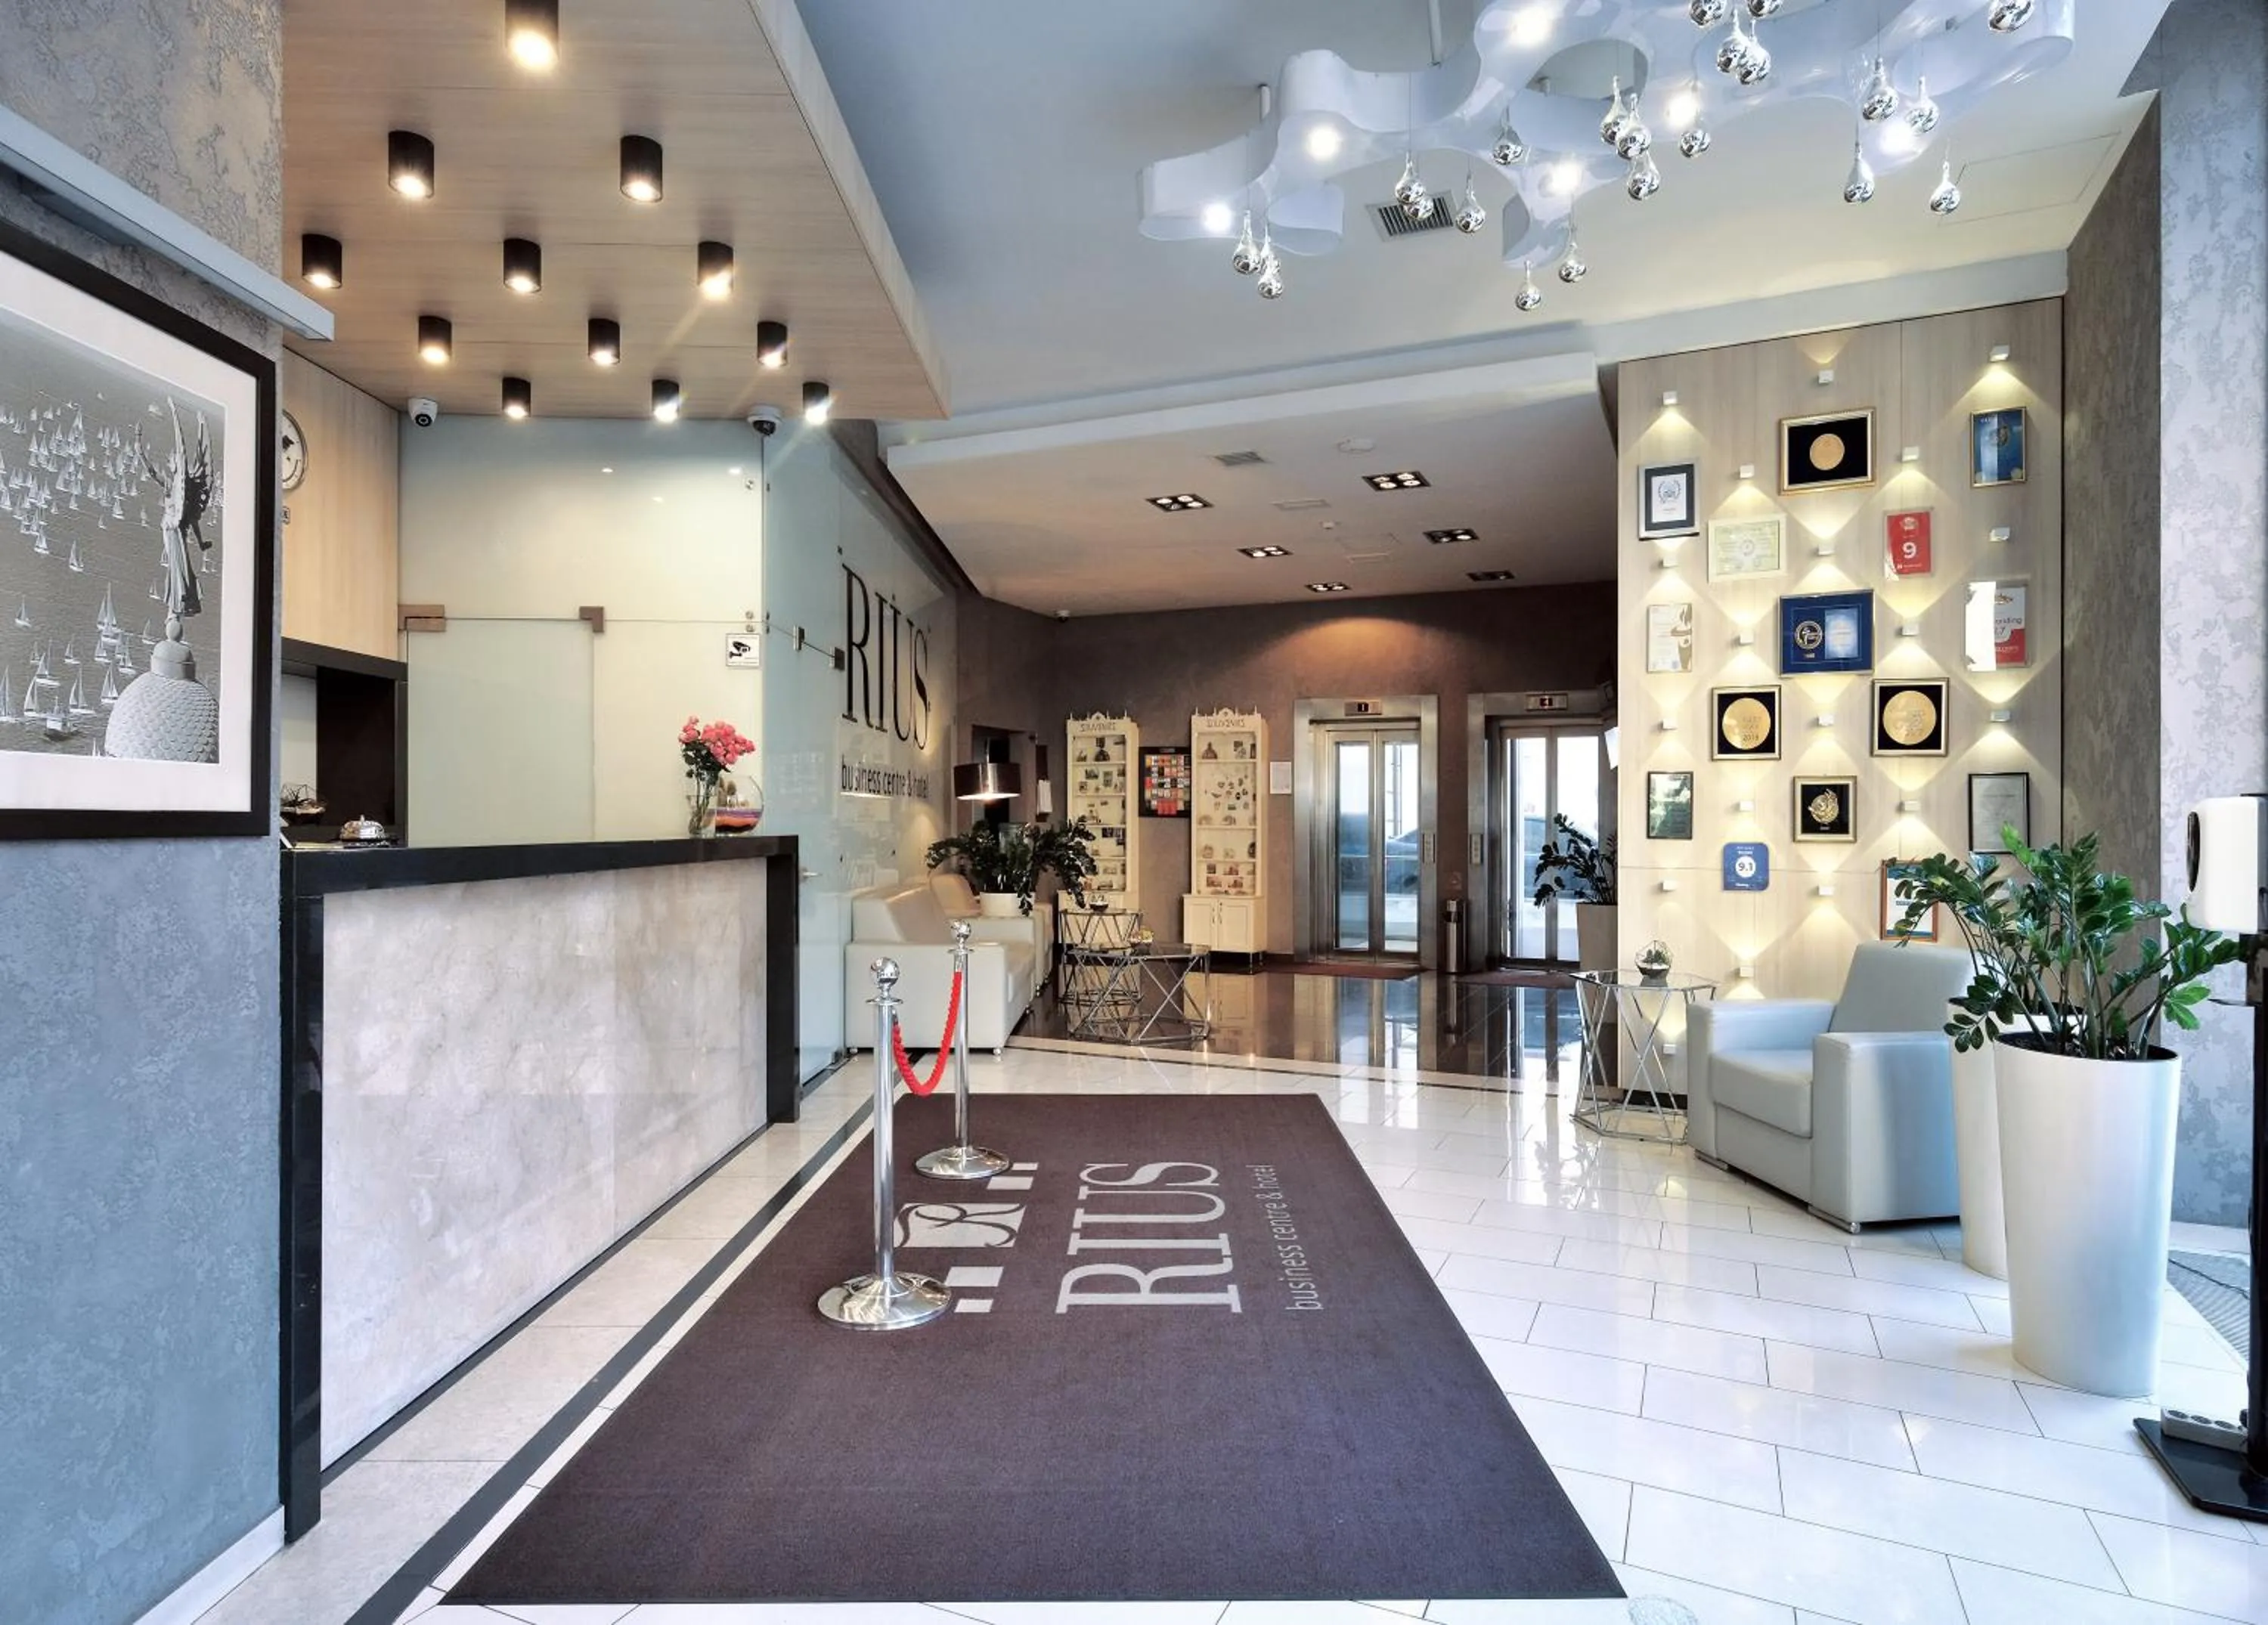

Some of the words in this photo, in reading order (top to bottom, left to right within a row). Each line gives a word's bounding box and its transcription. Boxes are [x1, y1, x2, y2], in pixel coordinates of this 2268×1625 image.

[1903, 541, 1916, 559] 9
[841, 562, 928, 751] RIUS
[841, 754, 881, 794] business
[1738, 862, 1753, 871] 9.1
[1244, 1165, 1280, 1190] hotel
[1255, 1192, 1283, 1200] &
[1055, 1162, 1242, 1314] RIUS
[1264, 1202, 1299, 1240] centre
[1278, 1244, 1325, 1310] business
